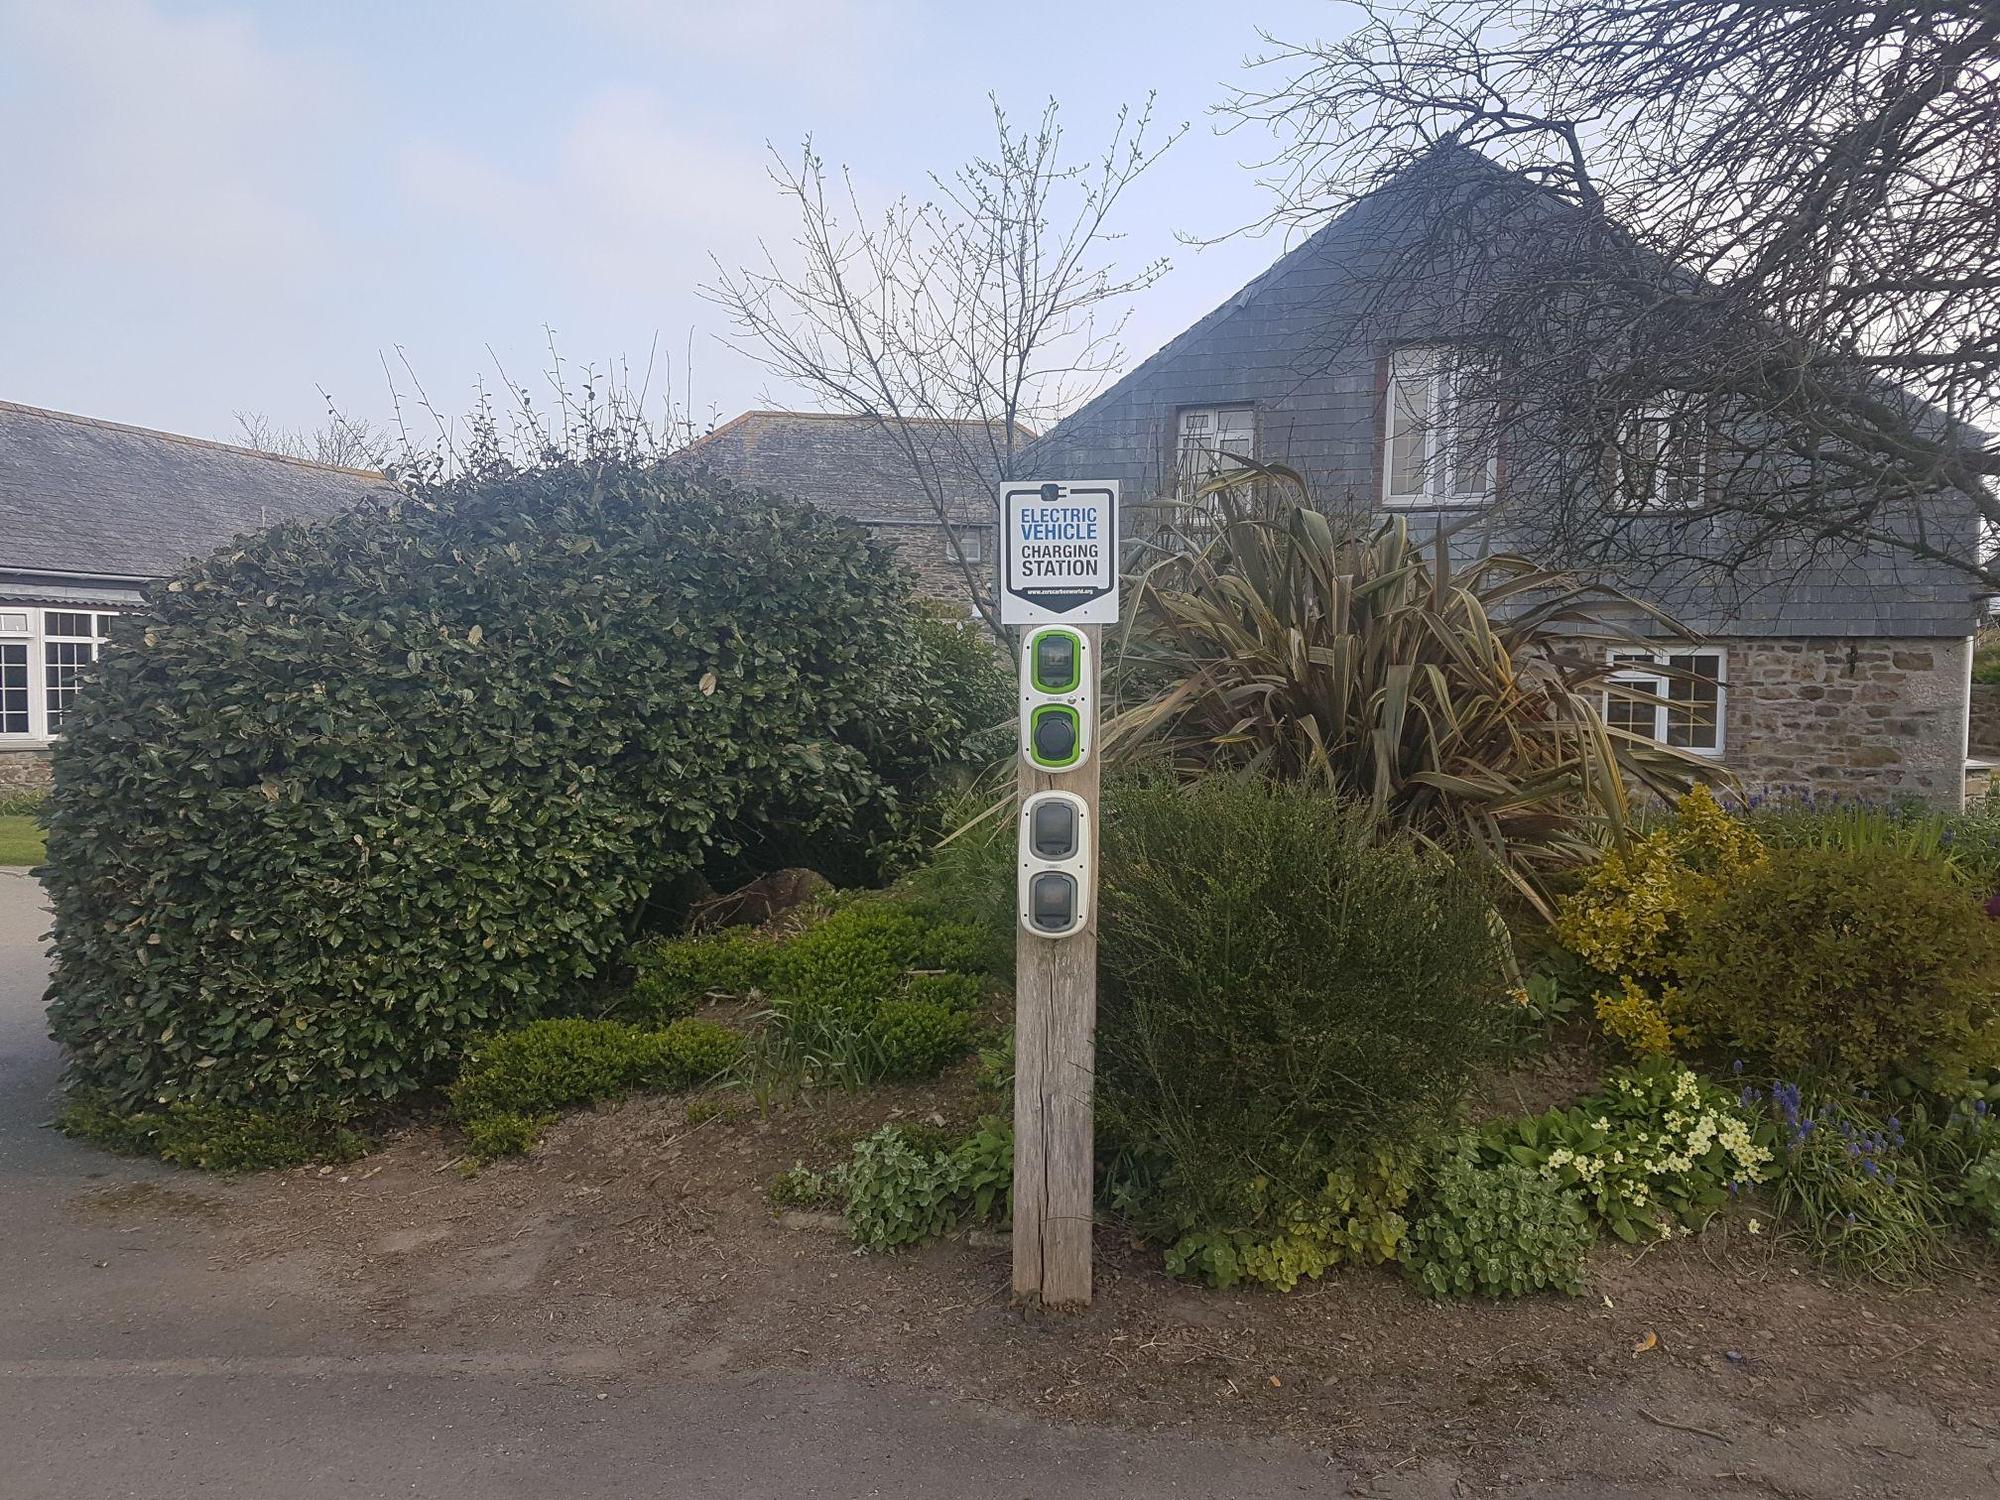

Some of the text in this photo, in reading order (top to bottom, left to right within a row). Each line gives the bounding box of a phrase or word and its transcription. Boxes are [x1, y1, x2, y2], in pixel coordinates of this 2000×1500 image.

[1021, 508, 1097, 523] ELECTRIC
[1021, 523, 1097, 540] VEHICLE
[1022, 544, 1098, 558] CHARGING
[1022, 560, 1098, 576] STATION
